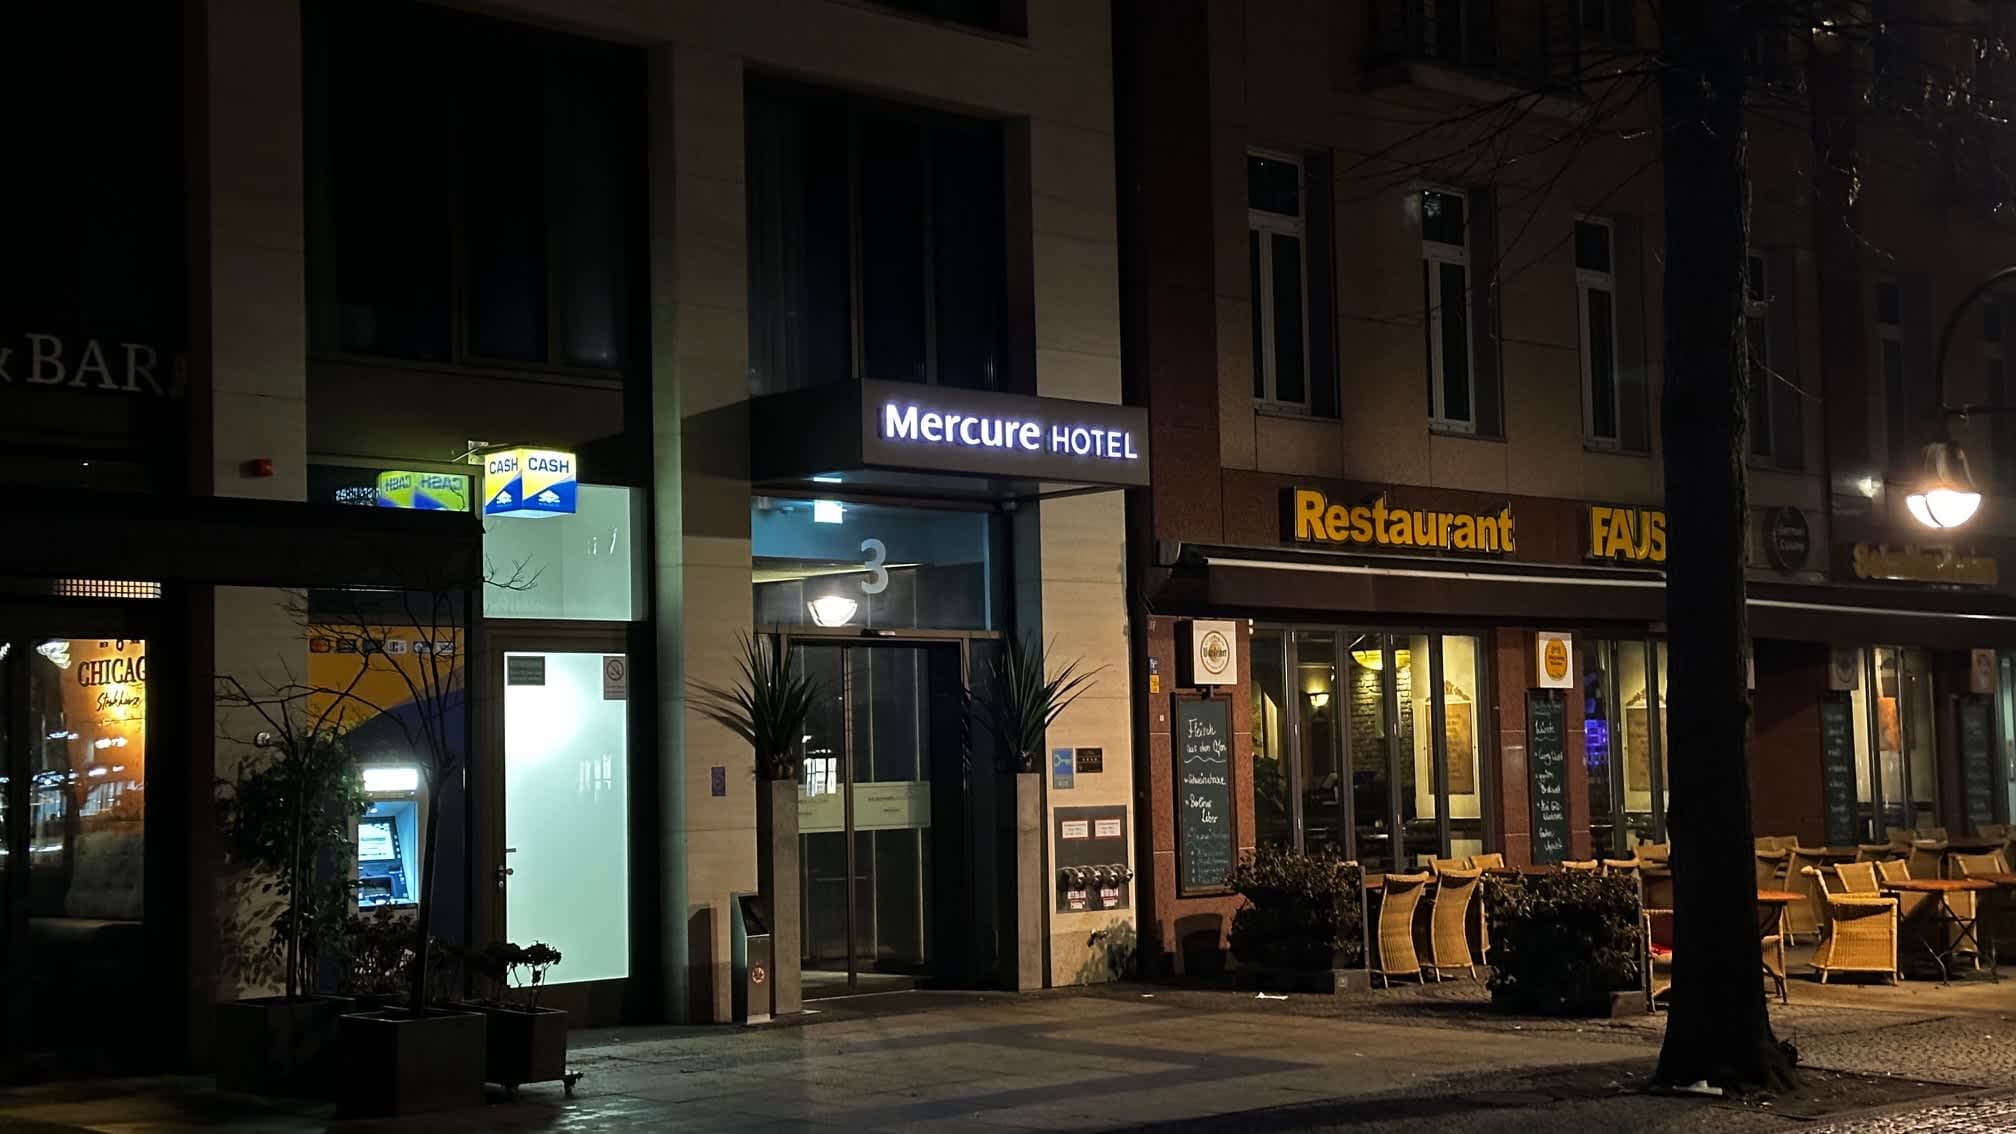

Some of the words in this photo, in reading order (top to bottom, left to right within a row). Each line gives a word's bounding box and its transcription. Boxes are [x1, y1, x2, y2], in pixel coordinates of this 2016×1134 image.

[24, 332, 165, 397] BAR
[886, 404, 1040, 450] Mercure
[1052, 425, 1138, 459] HOTEL
[489, 458, 518, 474] CASH
[528, 457, 569, 473] CASH
[1295, 489, 1516, 552] Restaurant
[861, 538, 889, 594] 3
